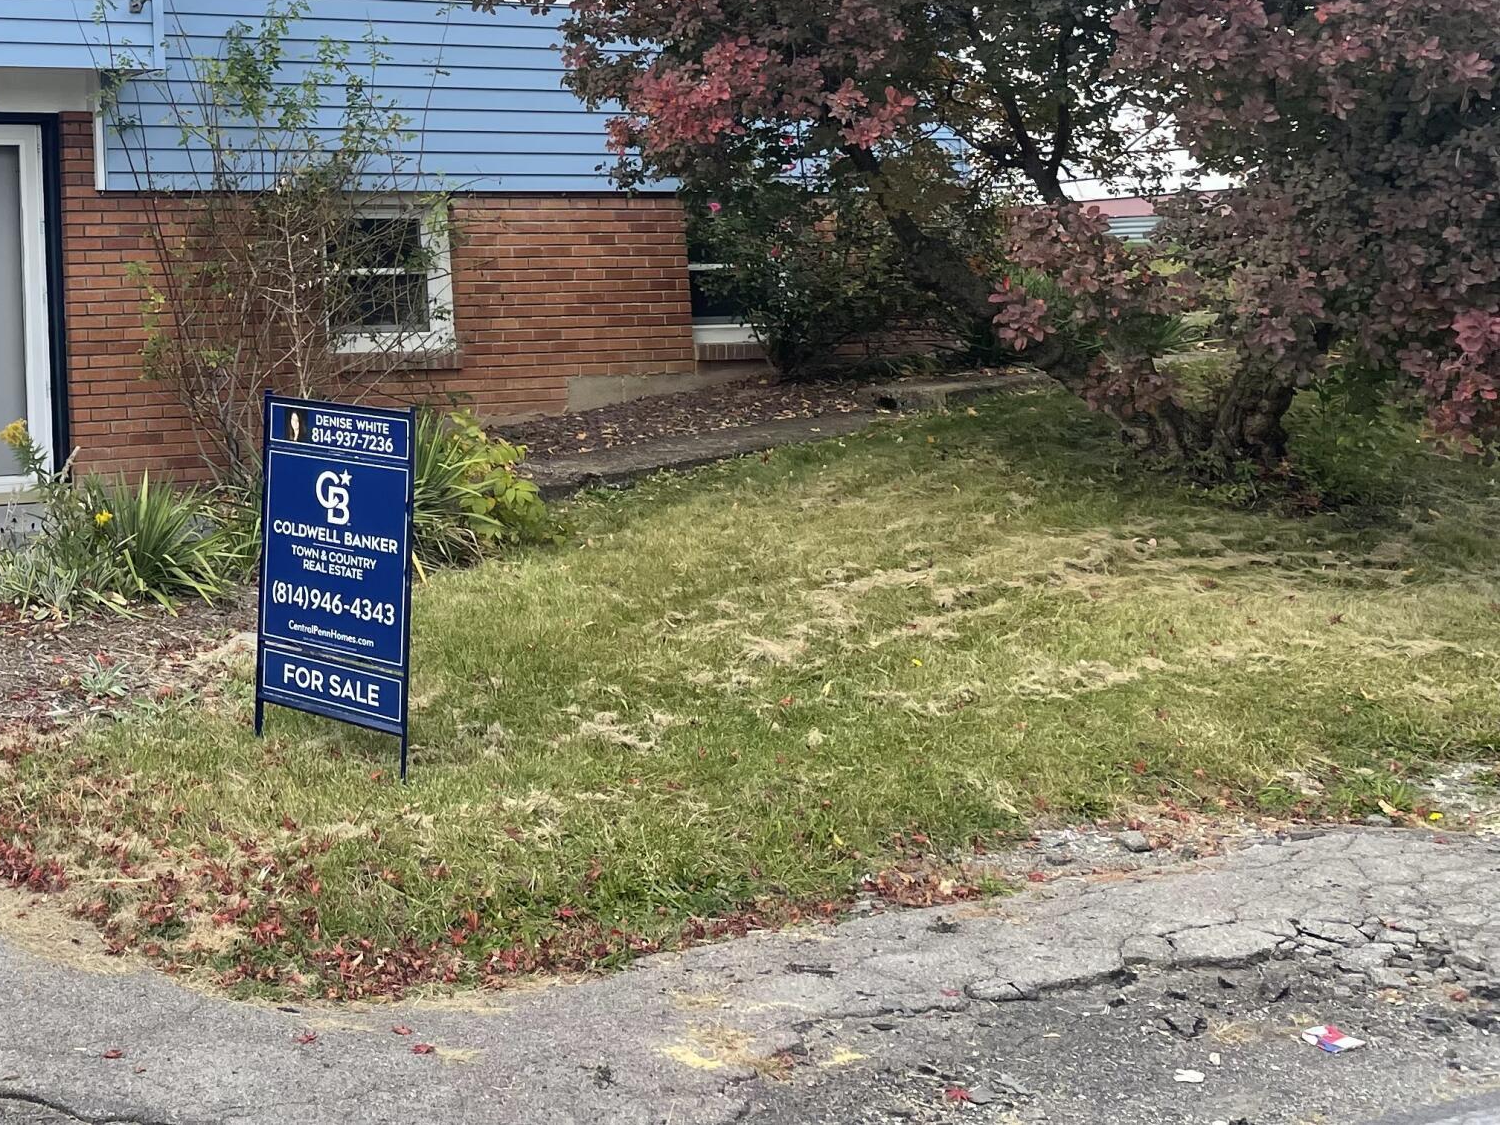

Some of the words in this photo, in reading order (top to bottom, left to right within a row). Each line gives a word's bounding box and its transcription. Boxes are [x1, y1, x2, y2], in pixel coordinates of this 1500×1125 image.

[315, 415, 353, 430] DENISE
[356, 419, 389, 434] WHITE
[311, 428, 393, 452] 814-937-7236
[273, 520, 340, 544] COLDWELL
[344, 531, 398, 555] BANKER
[291, 544, 320, 560] TOWN
[320, 550, 327, 561] &
[328, 551, 377, 570] COUNTRY
[302, 559, 327, 574] REAL
[328, 563, 364, 581] ESTATE
[288, 619, 375, 648] CentralPennHomes.com
[283, 663, 323, 692] FOR
[328, 677, 380, 707] SALE
